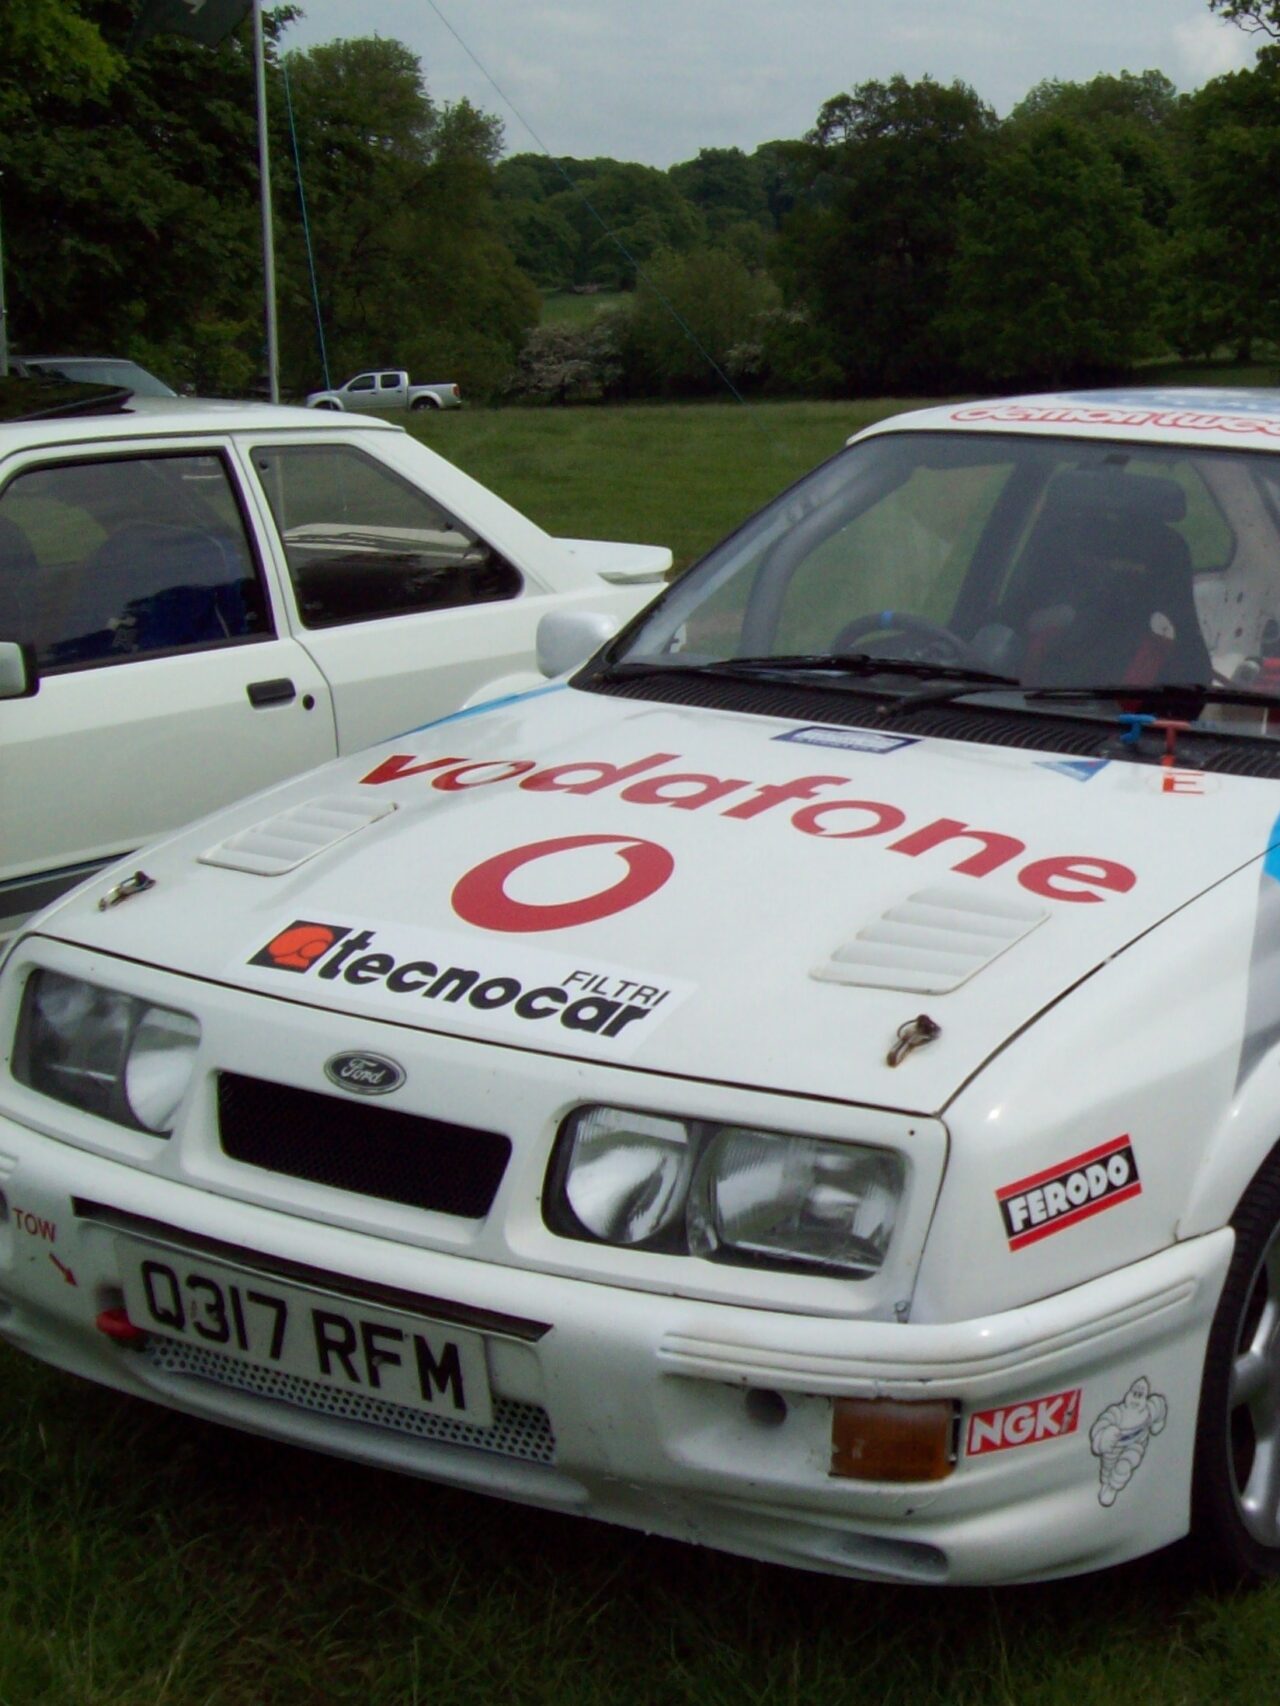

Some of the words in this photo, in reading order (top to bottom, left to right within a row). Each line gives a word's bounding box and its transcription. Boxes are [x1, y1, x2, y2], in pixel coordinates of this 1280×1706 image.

[358, 752, 1137, 903] vodafone
[317, 930, 652, 1038] tecnocar
[561, 970, 671, 1007] FILTRI
[339, 1056, 387, 1085] Ford
[12, 1207, 56, 1243] TOW
[1008, 1155, 1129, 1232] FERODO
[141, 1260, 287, 1360] Q317
[312, 1309, 466, 1410] RFM
[970, 1397, 1063, 1454] NGK
